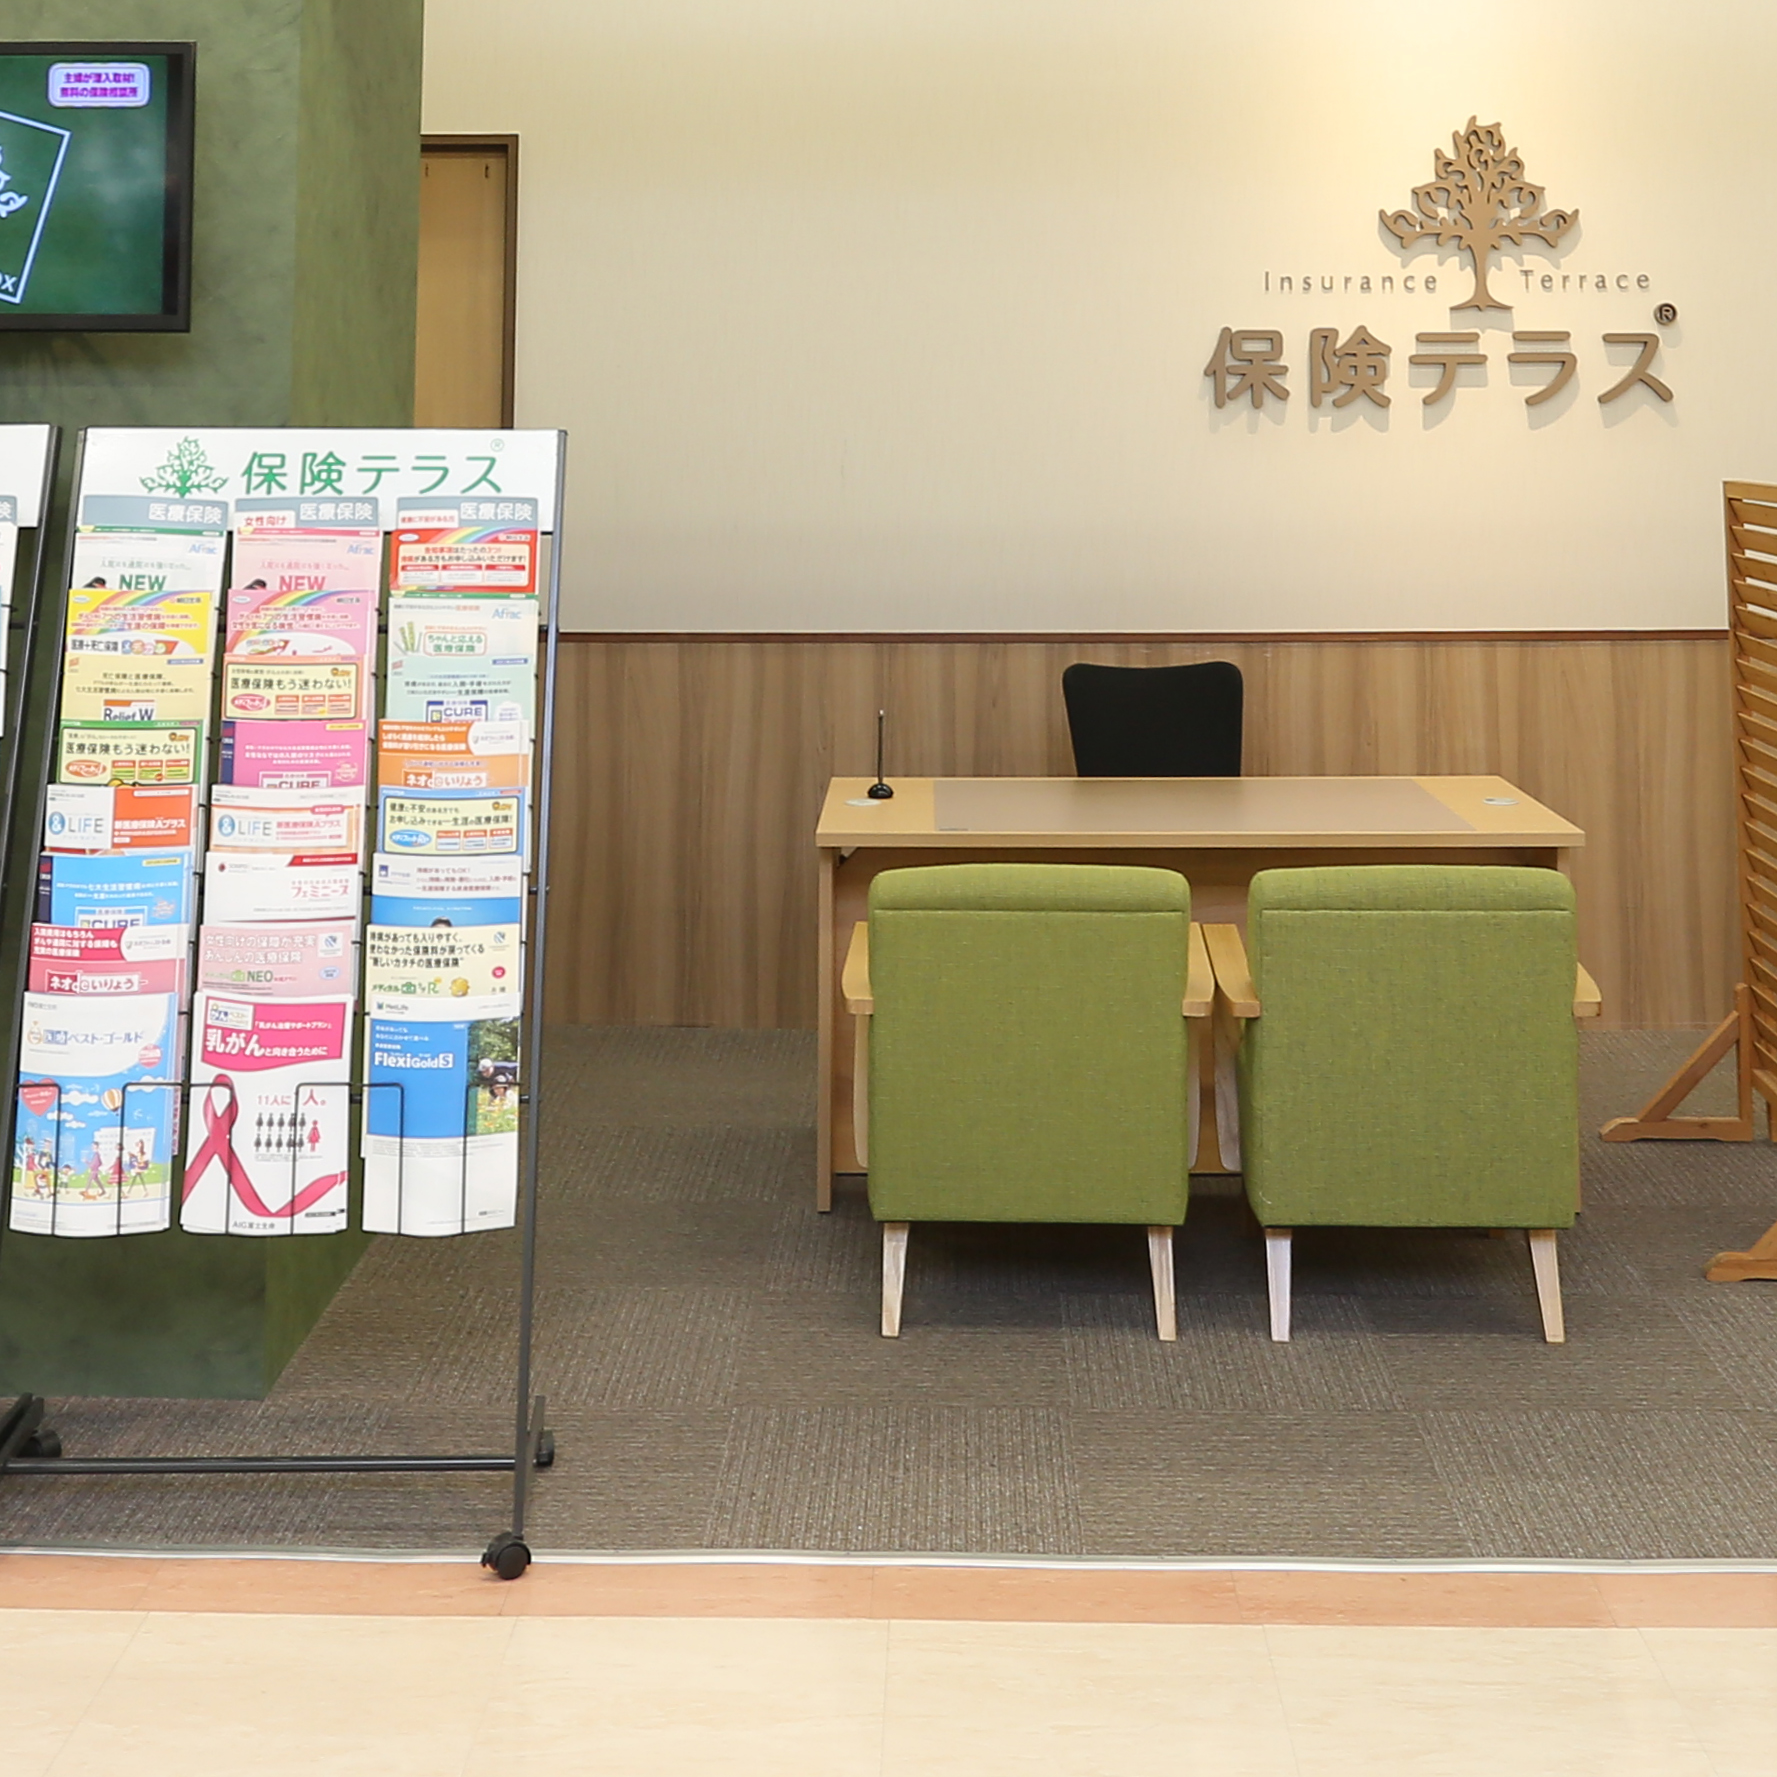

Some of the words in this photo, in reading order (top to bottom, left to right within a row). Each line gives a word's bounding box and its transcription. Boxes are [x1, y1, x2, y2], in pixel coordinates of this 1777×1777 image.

[1263, 270, 1439, 293] Insurance
[1518, 268, 1652, 291] Terrace
[1203, 324, 1675, 410] 保険テラス
[241, 450, 503, 496] 保険テラス
[148, 503, 223, 524] 医療保険
[299, 502, 374, 521] 医療保険
[460, 502, 534, 521] 医療保険
[244, 516, 288, 527] 女性向け
[119, 574, 167, 590] NEW
[279, 575, 327, 590] NEW
[230, 677, 352, 691] 医療保険もう迷わない!
[443, 706, 483, 717] CURE
[65, 742, 190, 756] 医療保険もう迷わない!
[246, 970, 274, 983] NEO
